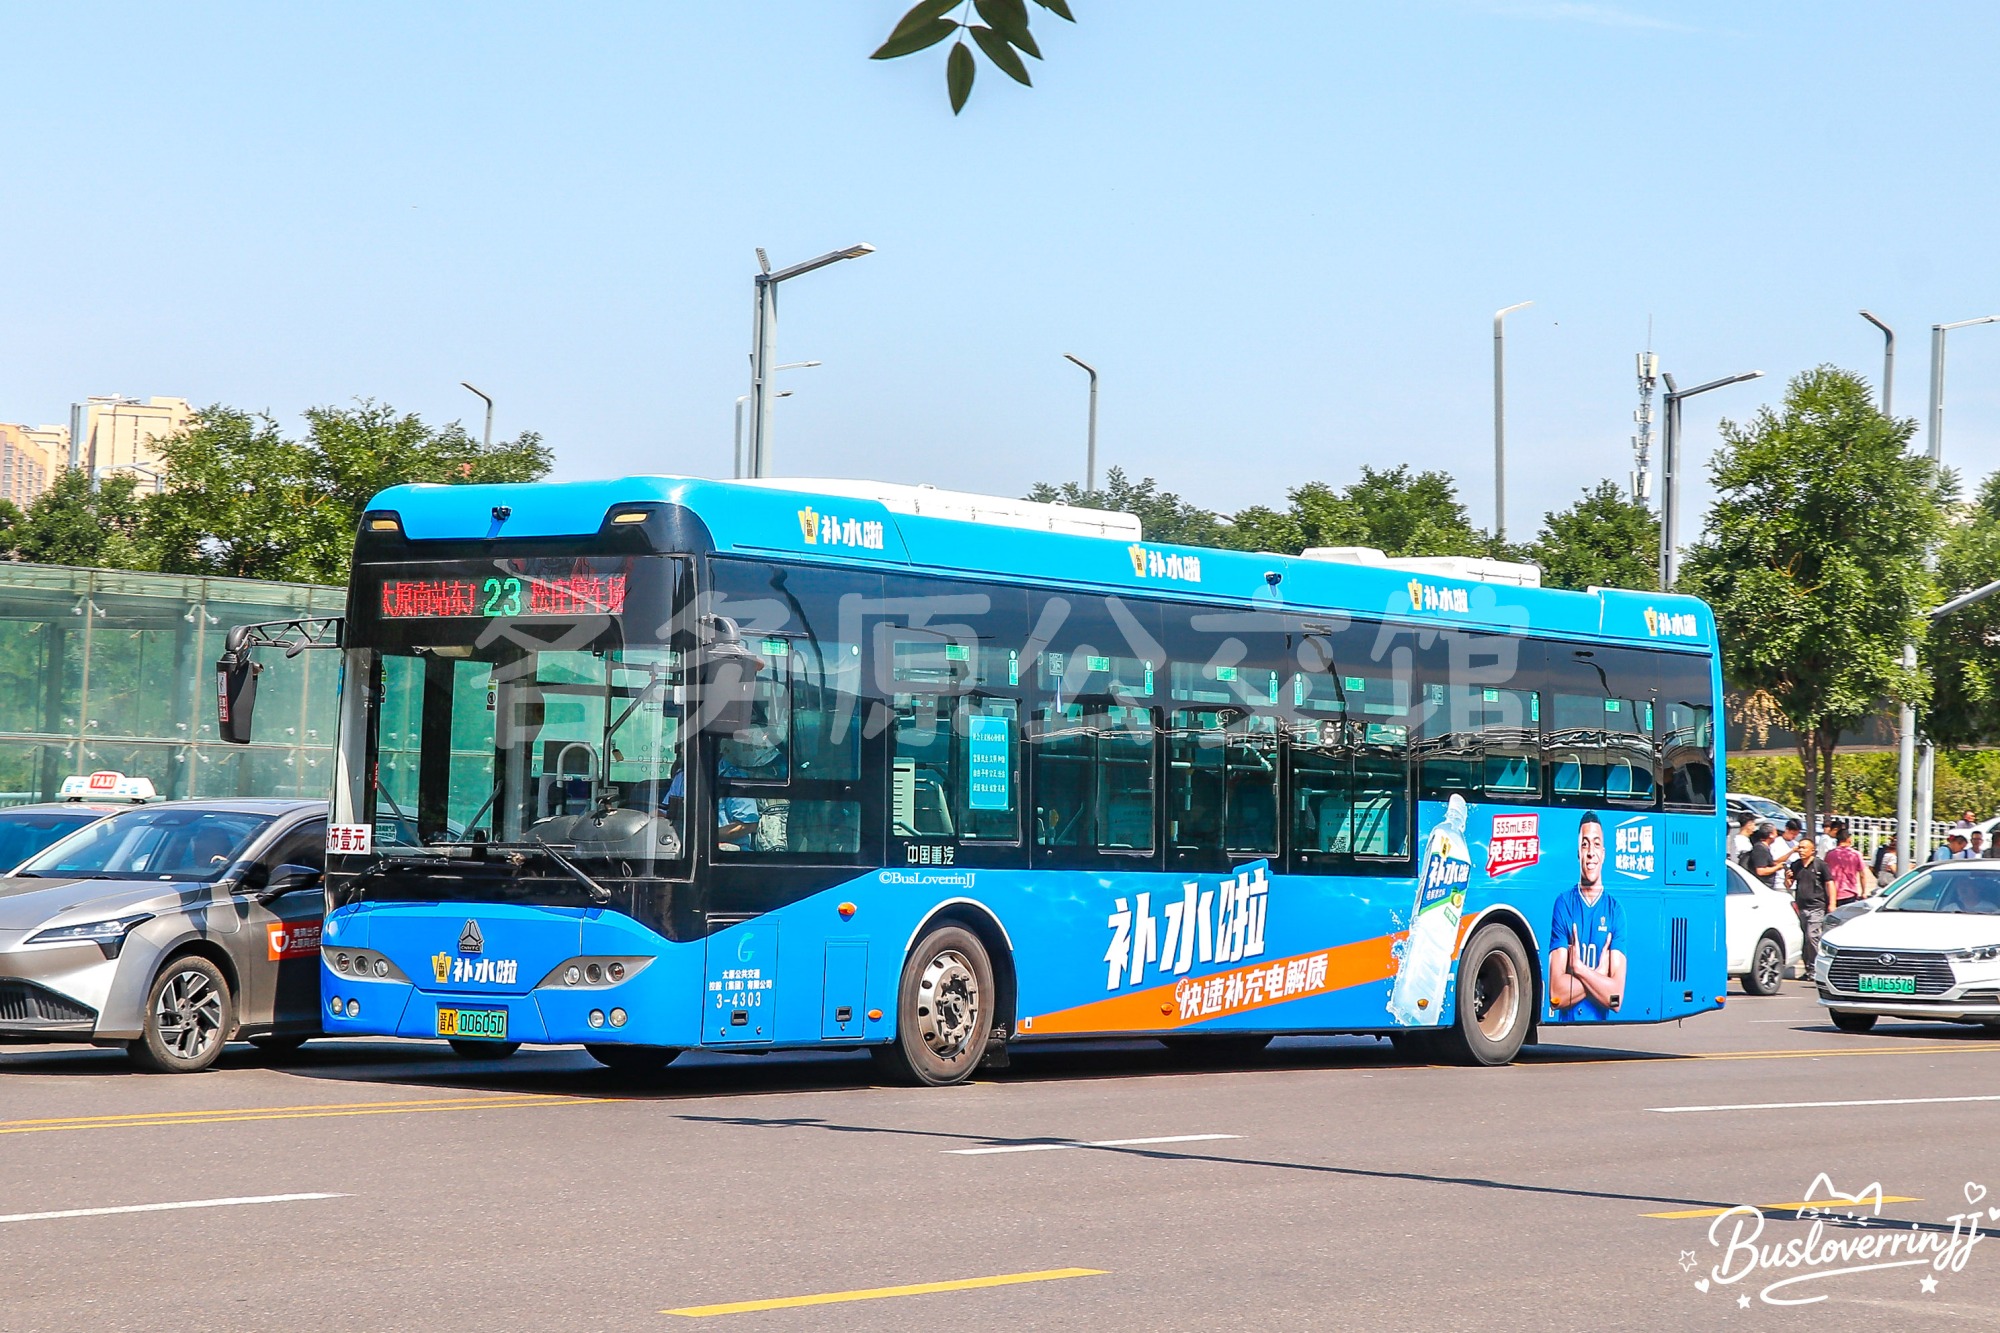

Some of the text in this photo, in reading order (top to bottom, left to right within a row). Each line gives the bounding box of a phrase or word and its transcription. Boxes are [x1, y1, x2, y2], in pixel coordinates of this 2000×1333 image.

[821, 514, 884, 550] 补水啦
[1148, 550, 1201, 583] 补水啦
[483, 577, 522, 617] 23
[1424, 585, 1469, 613] 补水啦
[1657, 612, 1697, 637] 补水啦
[92, 775, 115, 787] TAXI
[907, 845, 955, 865] 中国重汽
[1488, 838, 1538, 866] 免费乐享
[1428, 856, 1470, 888] 补水啦
[1103, 868, 1269, 992] 补水啦
[453, 957, 518, 984] 补水啦
[722, 969, 760, 979] 太原公共交通
[716, 991, 762, 1009] 3-4303
[1179, 953, 1329, 1020] 快速补充电解质
